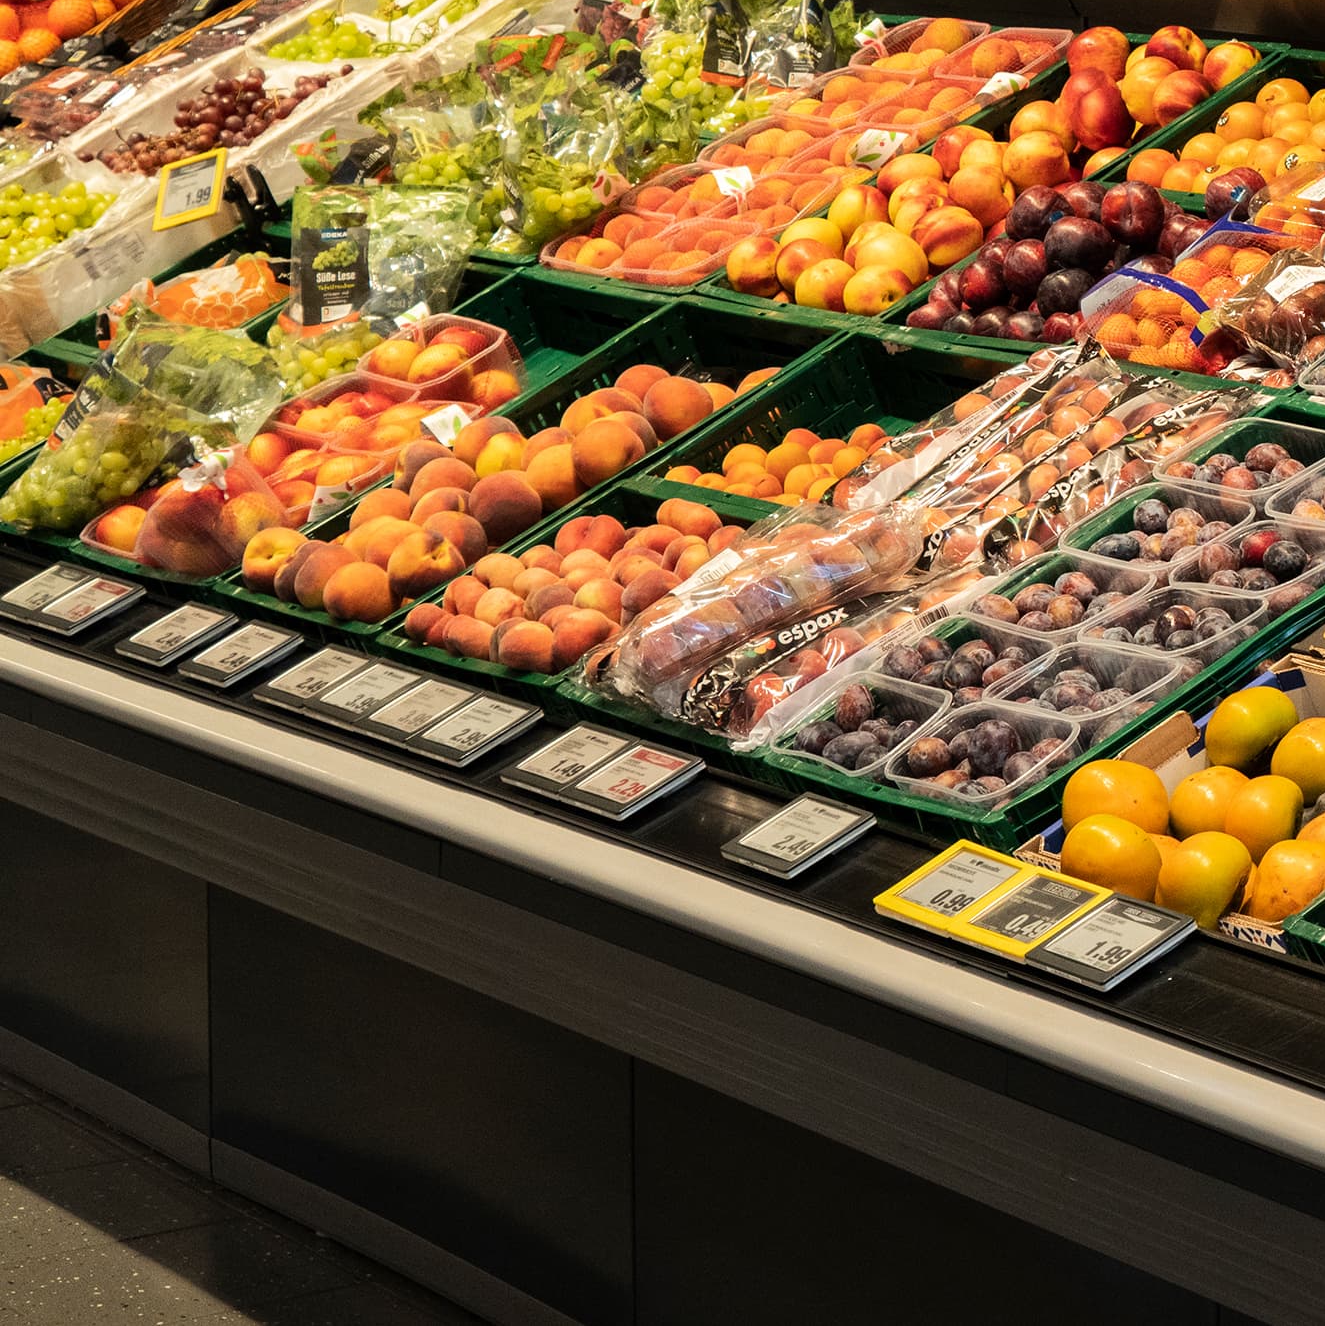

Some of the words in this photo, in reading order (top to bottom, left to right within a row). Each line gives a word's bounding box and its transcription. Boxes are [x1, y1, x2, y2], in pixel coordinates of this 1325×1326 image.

[185, 185, 212, 206] 1.99
[778, 606, 849, 646] espax
[549, 759, 586, 777] 1.49
[608, 778, 647, 797] 2.29
[771, 834, 816, 856] 2.49
[930, 889, 977, 912] 0.99
[1005, 913, 1053, 938] 0.49
[1085, 940, 1133, 964] 1.99
